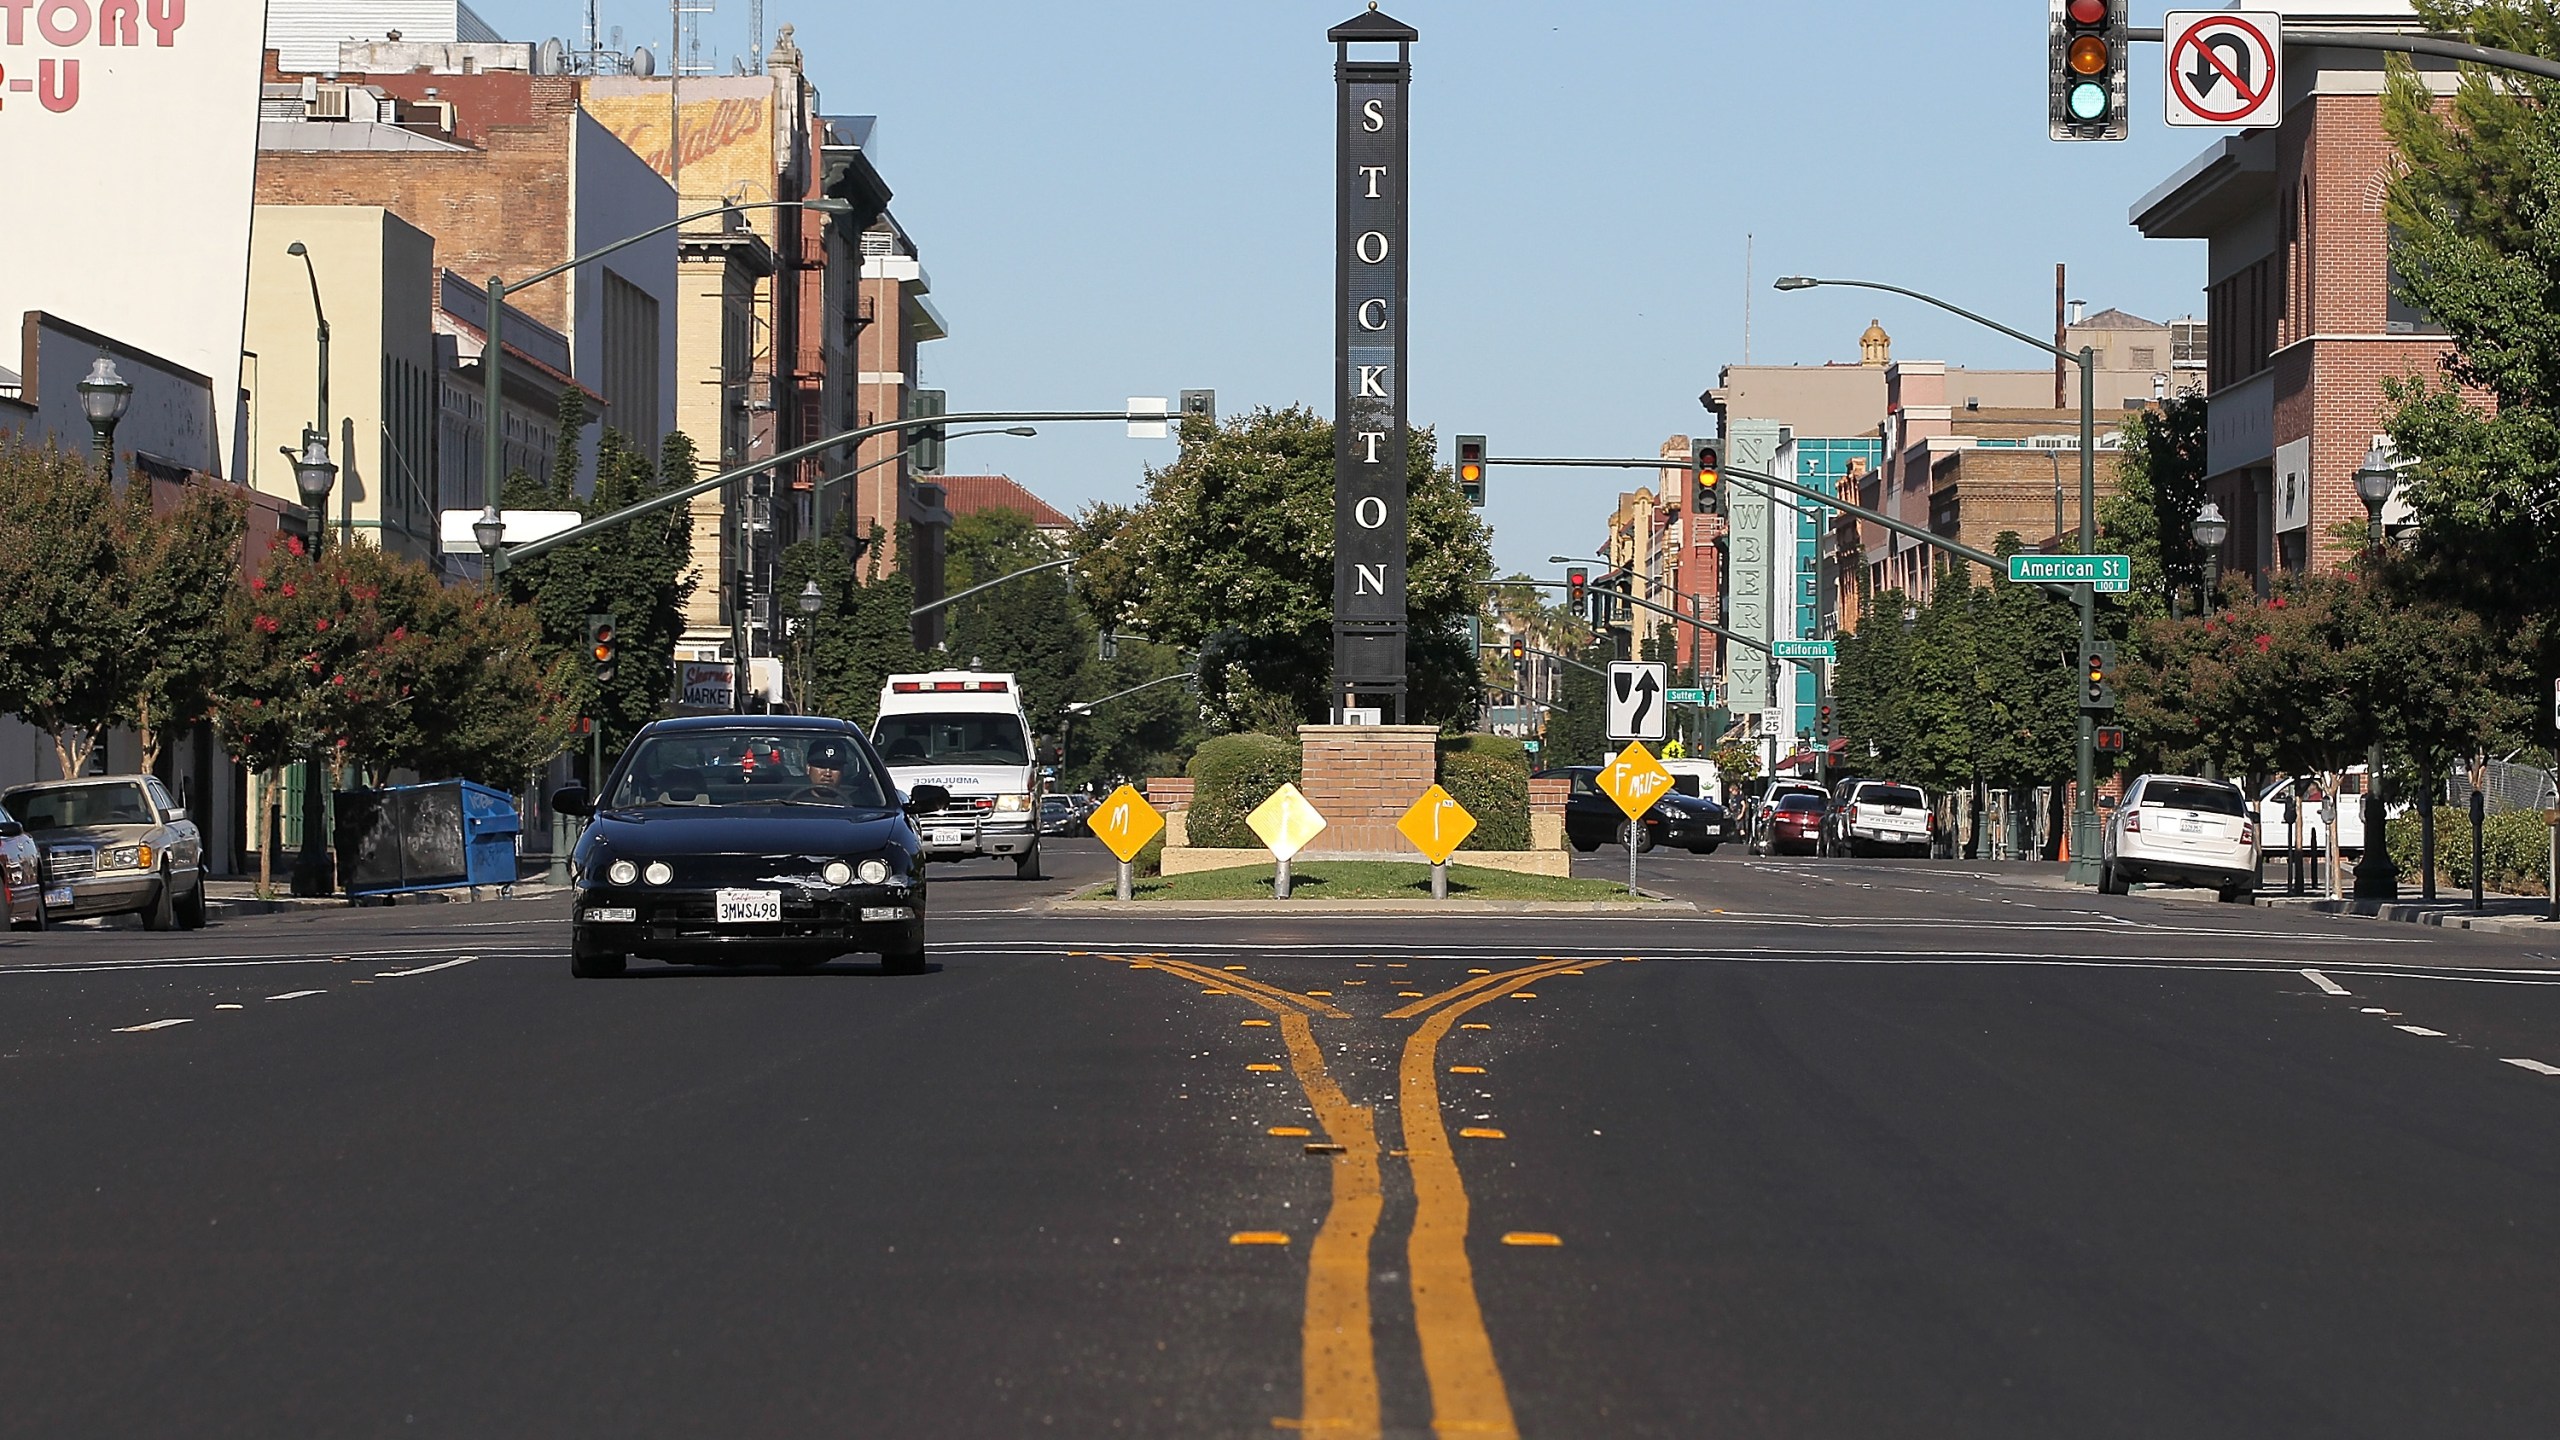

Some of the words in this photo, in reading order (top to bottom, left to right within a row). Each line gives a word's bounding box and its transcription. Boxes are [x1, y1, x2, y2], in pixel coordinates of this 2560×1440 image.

[1354, 99, 1388, 596] STOCKTON
[2020, 560, 2094, 577] American
[2102, 560, 2119, 577] St
[2100, 581, 2114, 590] 100
[1778, 644, 1828, 655] California
[684, 687, 733, 704] MARKET
[1671, 691, 1697, 700] Sutter
[1765, 722, 1779, 731] 25
[1109, 803, 1129, 836] M
[721, 903, 778, 919] 3MWS498
